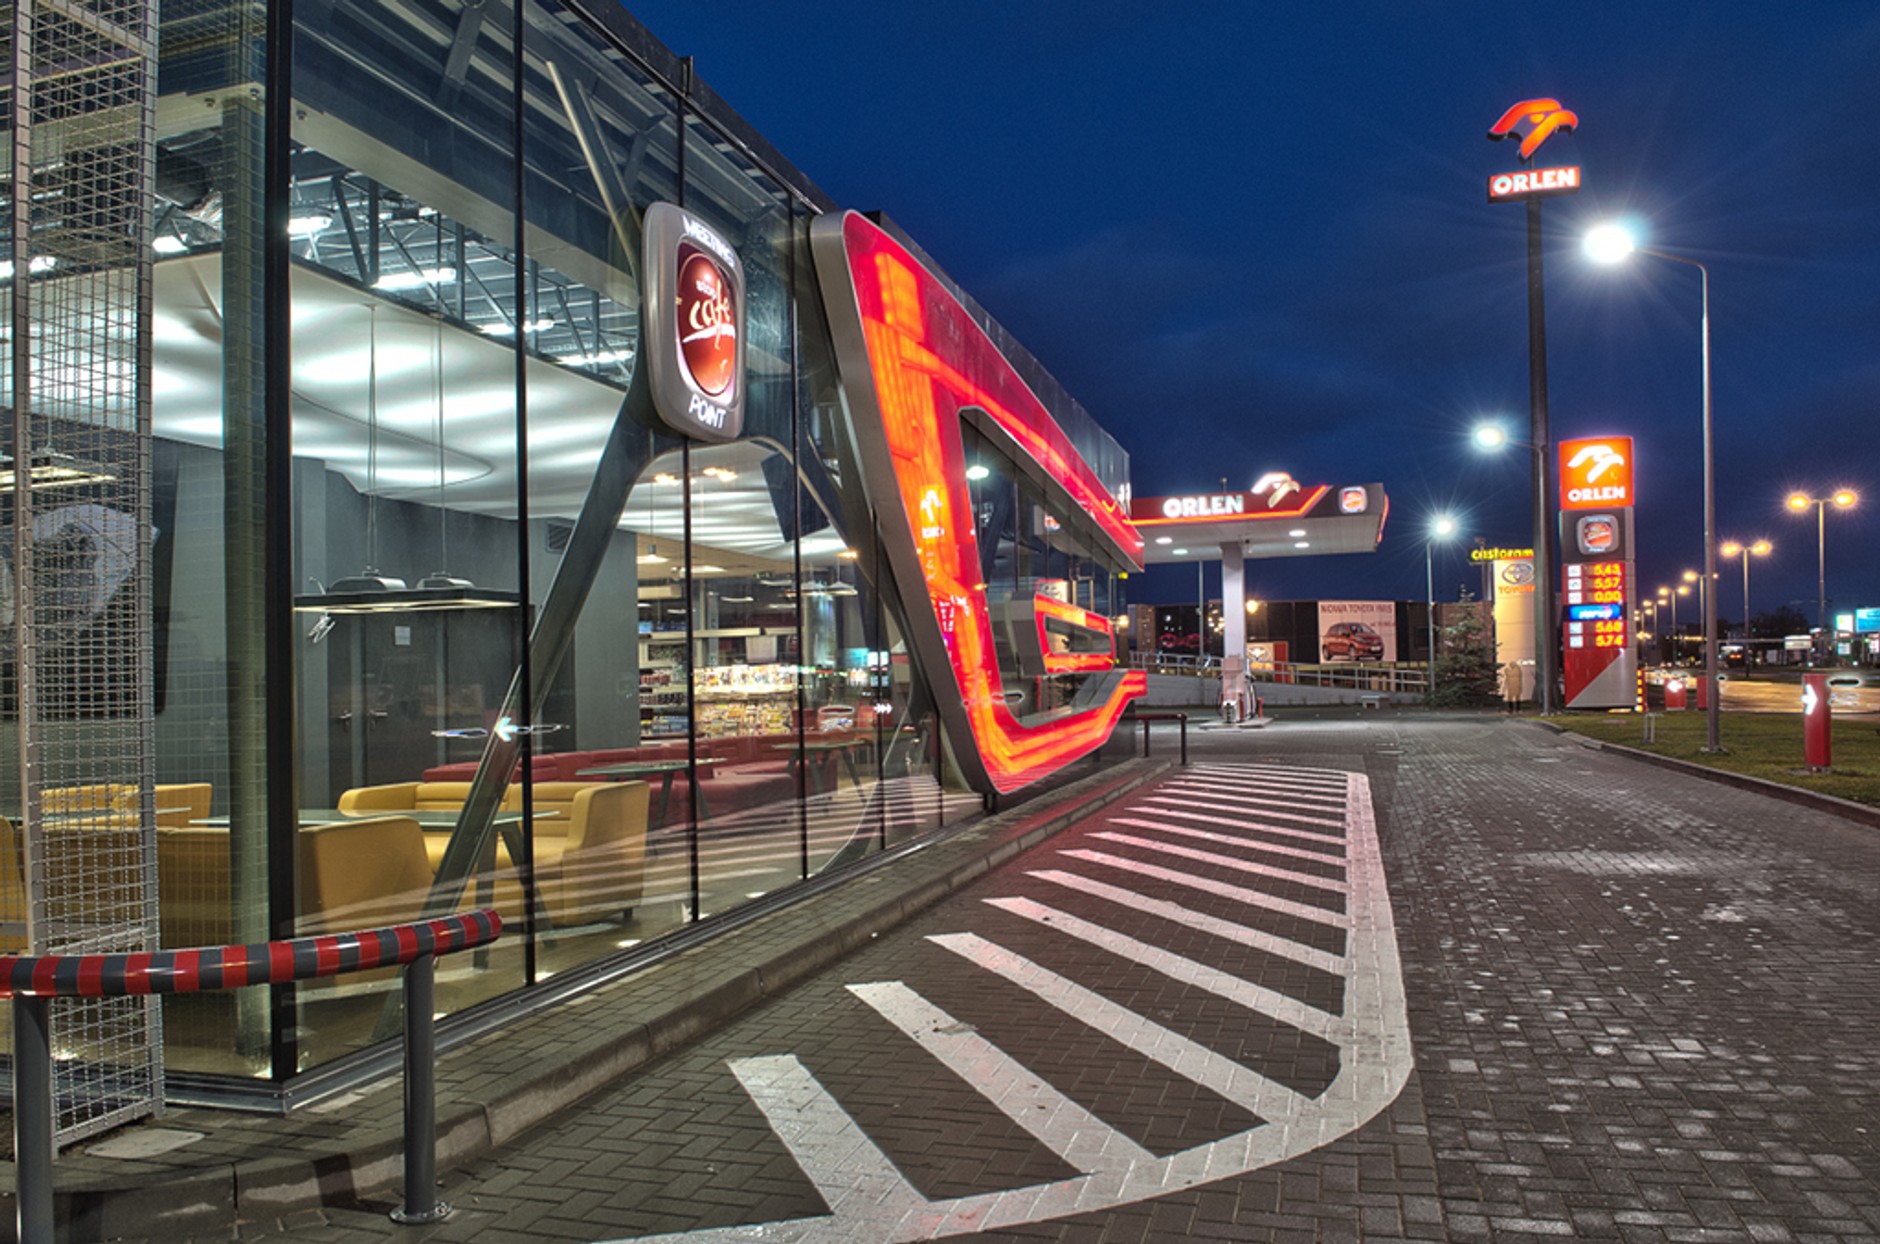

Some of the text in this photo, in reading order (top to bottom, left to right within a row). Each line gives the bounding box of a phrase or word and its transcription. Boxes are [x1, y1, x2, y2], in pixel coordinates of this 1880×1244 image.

[1494, 169, 1575, 195] ORLEN
[682, 214, 735, 268] MEETING
[689, 393, 727, 429] POINT
[1163, 494, 1243, 518] ORLEN
[1568, 486, 1625, 502] ORLEN
[1471, 548, 1534, 560] castoram
